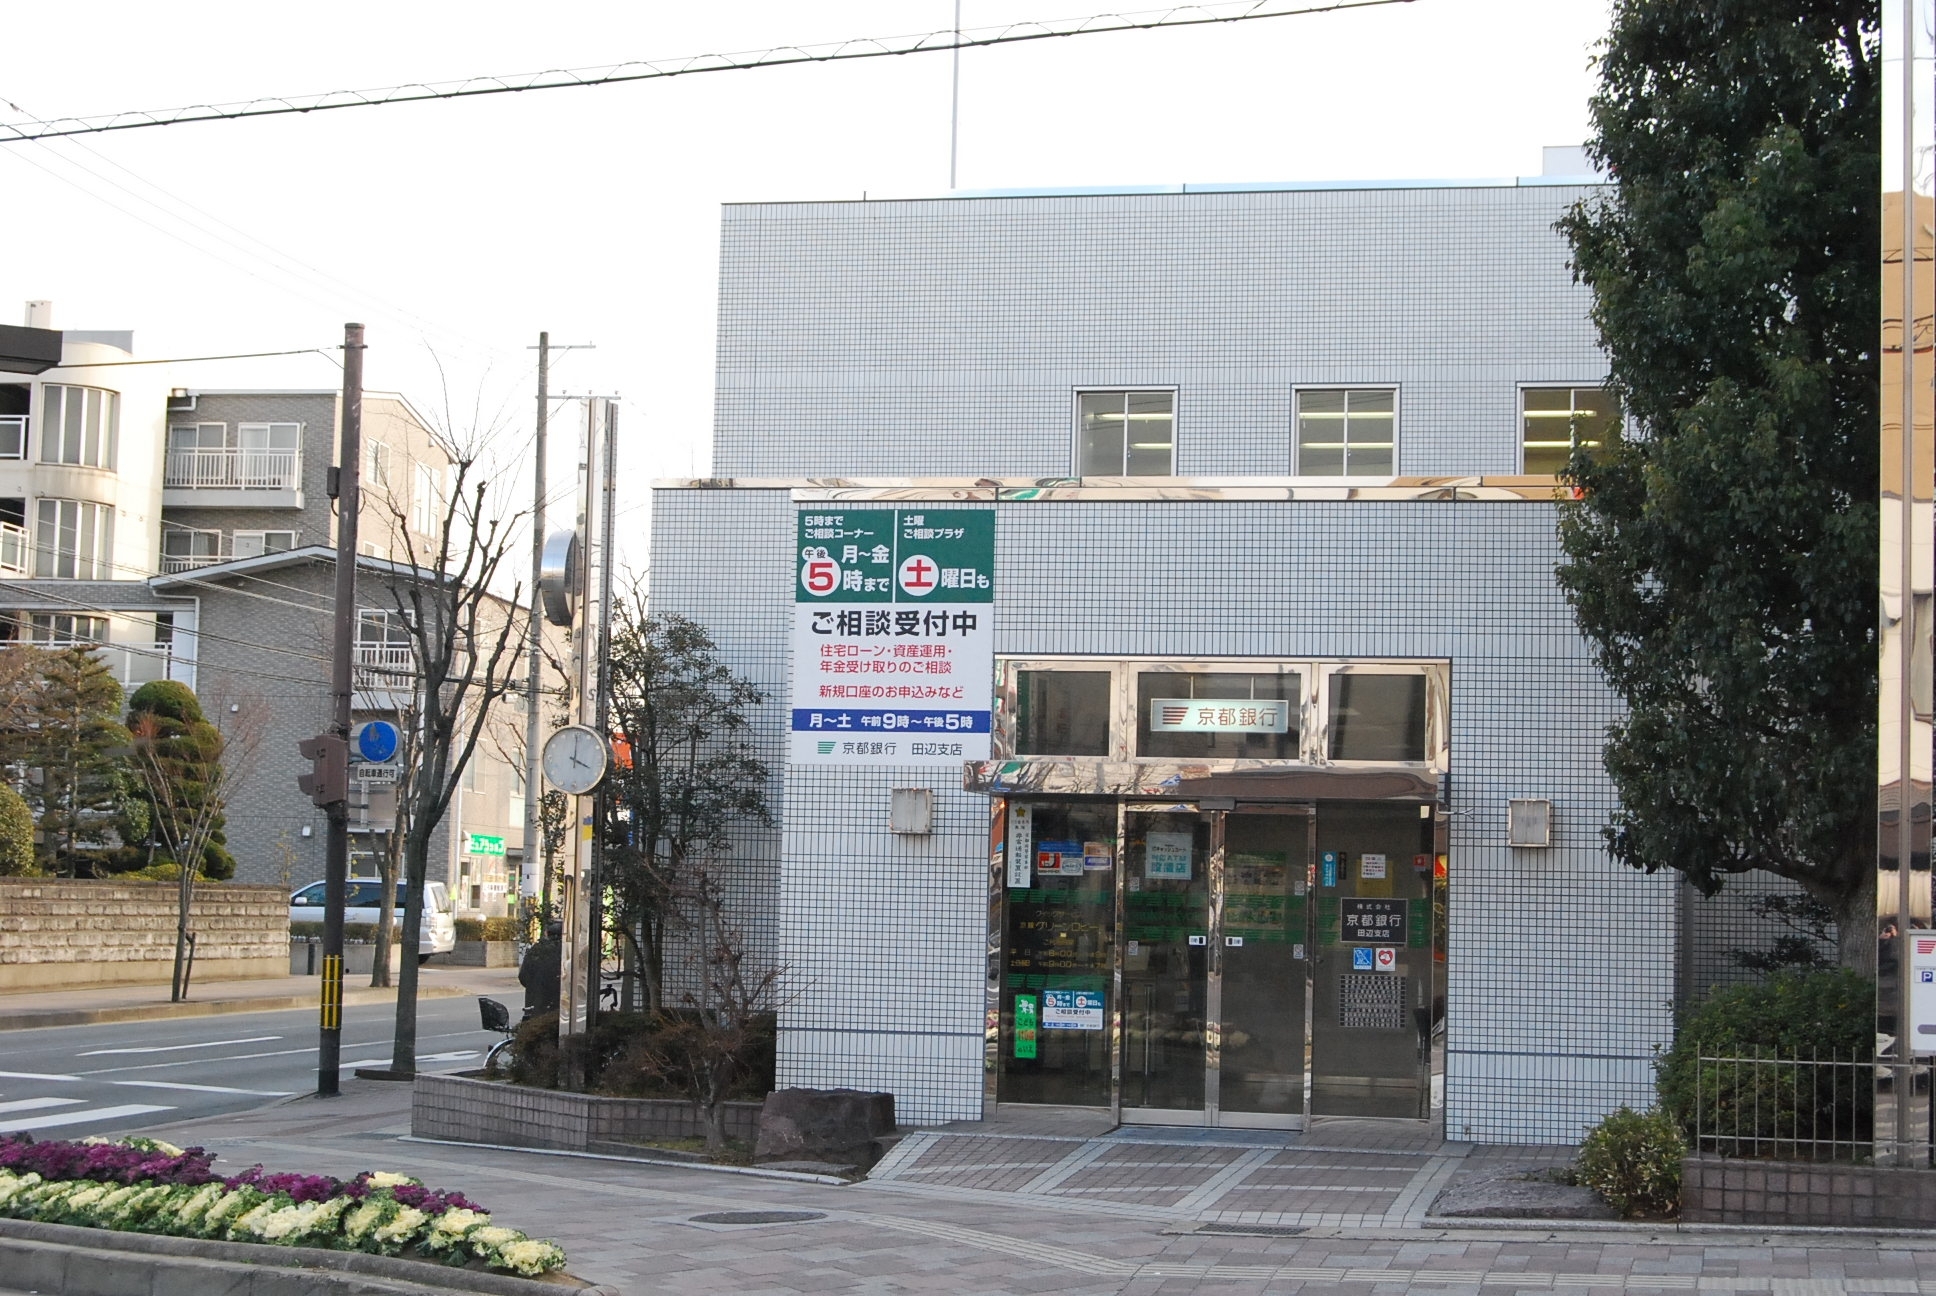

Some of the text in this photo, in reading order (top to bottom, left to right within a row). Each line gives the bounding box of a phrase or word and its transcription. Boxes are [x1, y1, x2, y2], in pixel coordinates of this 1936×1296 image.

[804, 515, 844, 526] 5時まで
[903, 515, 925, 526] 土曜
[804, 528, 874, 539] ご相談コーナー
[903, 528, 965, 540] ご相談プラザ
[804, 549, 827, 559] 午後
[811, 610, 978, 637] ご相談受付中
[819, 660, 952, 674] 年金受け取りのご相談
[819, 685, 964, 699] 新規口座のお申込みなど
[1197, 707, 1278, 727] 京都銀行
[842, 742, 963, 756] 京都銀行 田辺支店
[359, 768, 395, 778] 自転車通行可
[1346, 914, 1402, 927] 京都銀行
[1357, 929, 1390, 938] 田辺支店
